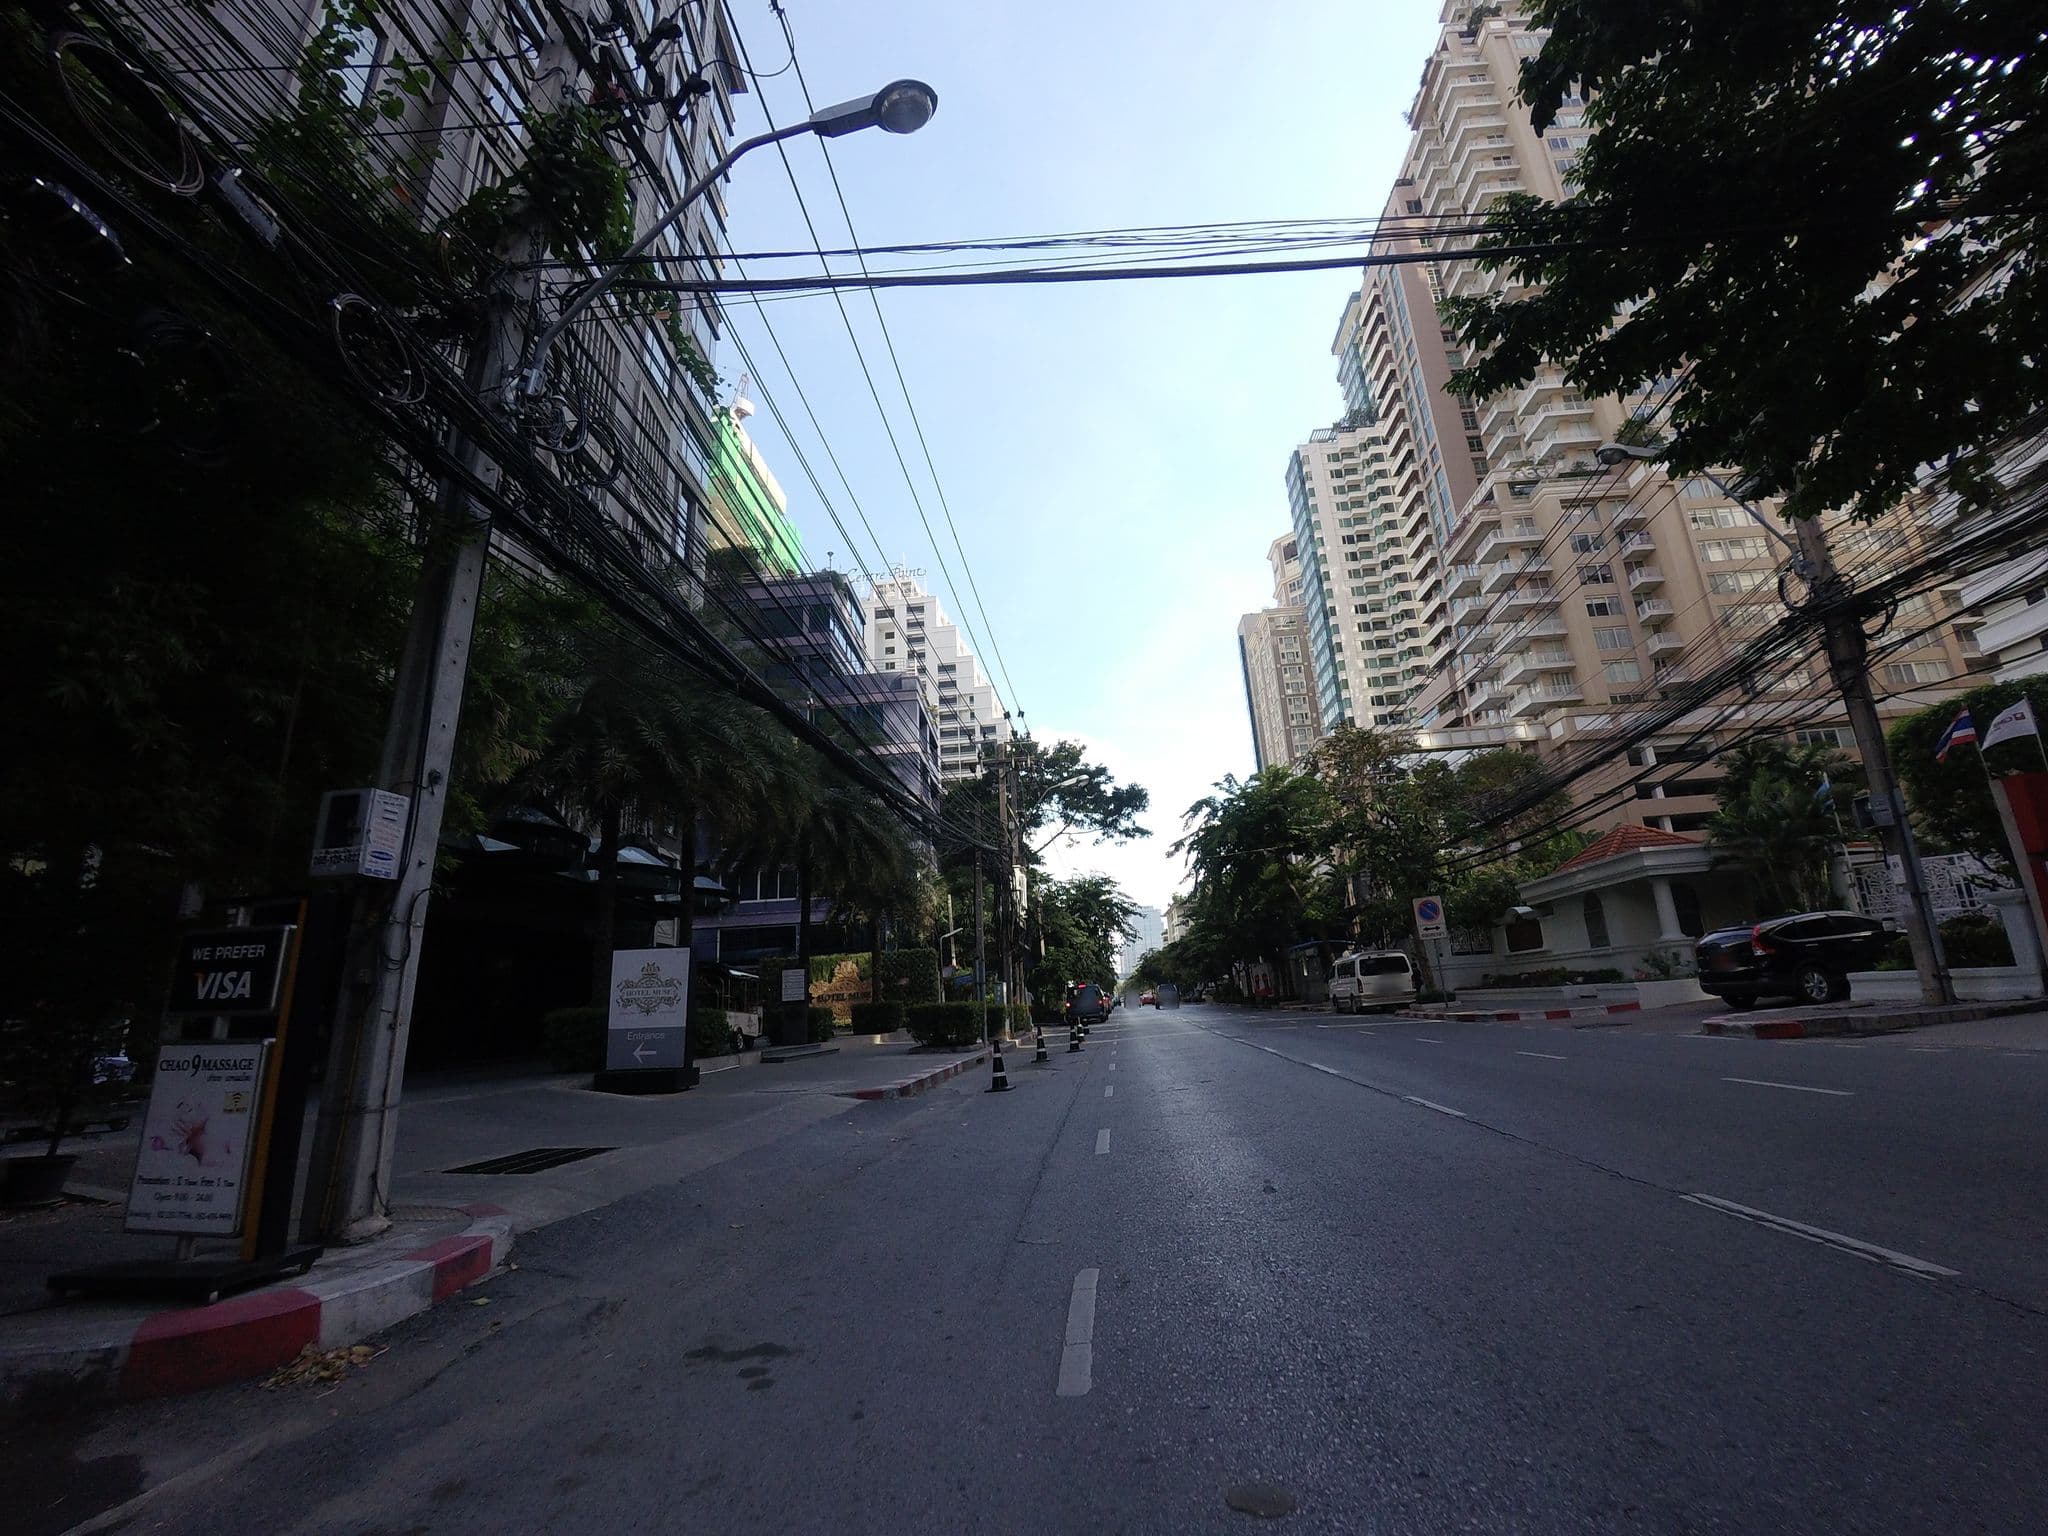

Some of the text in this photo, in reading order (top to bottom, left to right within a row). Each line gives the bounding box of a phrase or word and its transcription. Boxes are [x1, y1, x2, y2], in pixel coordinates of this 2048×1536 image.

[193, 945, 266, 960] WE PREFER
[194, 971, 252, 1000] VISA
[626, 989, 651, 997] HOTEL
[627, 1031, 665, 1040] Entrance
[159, 1059, 190, 1071] CHAO
[191, 1055, 201, 1078] 9
[202, 1058, 255, 1071] MASSAGE
